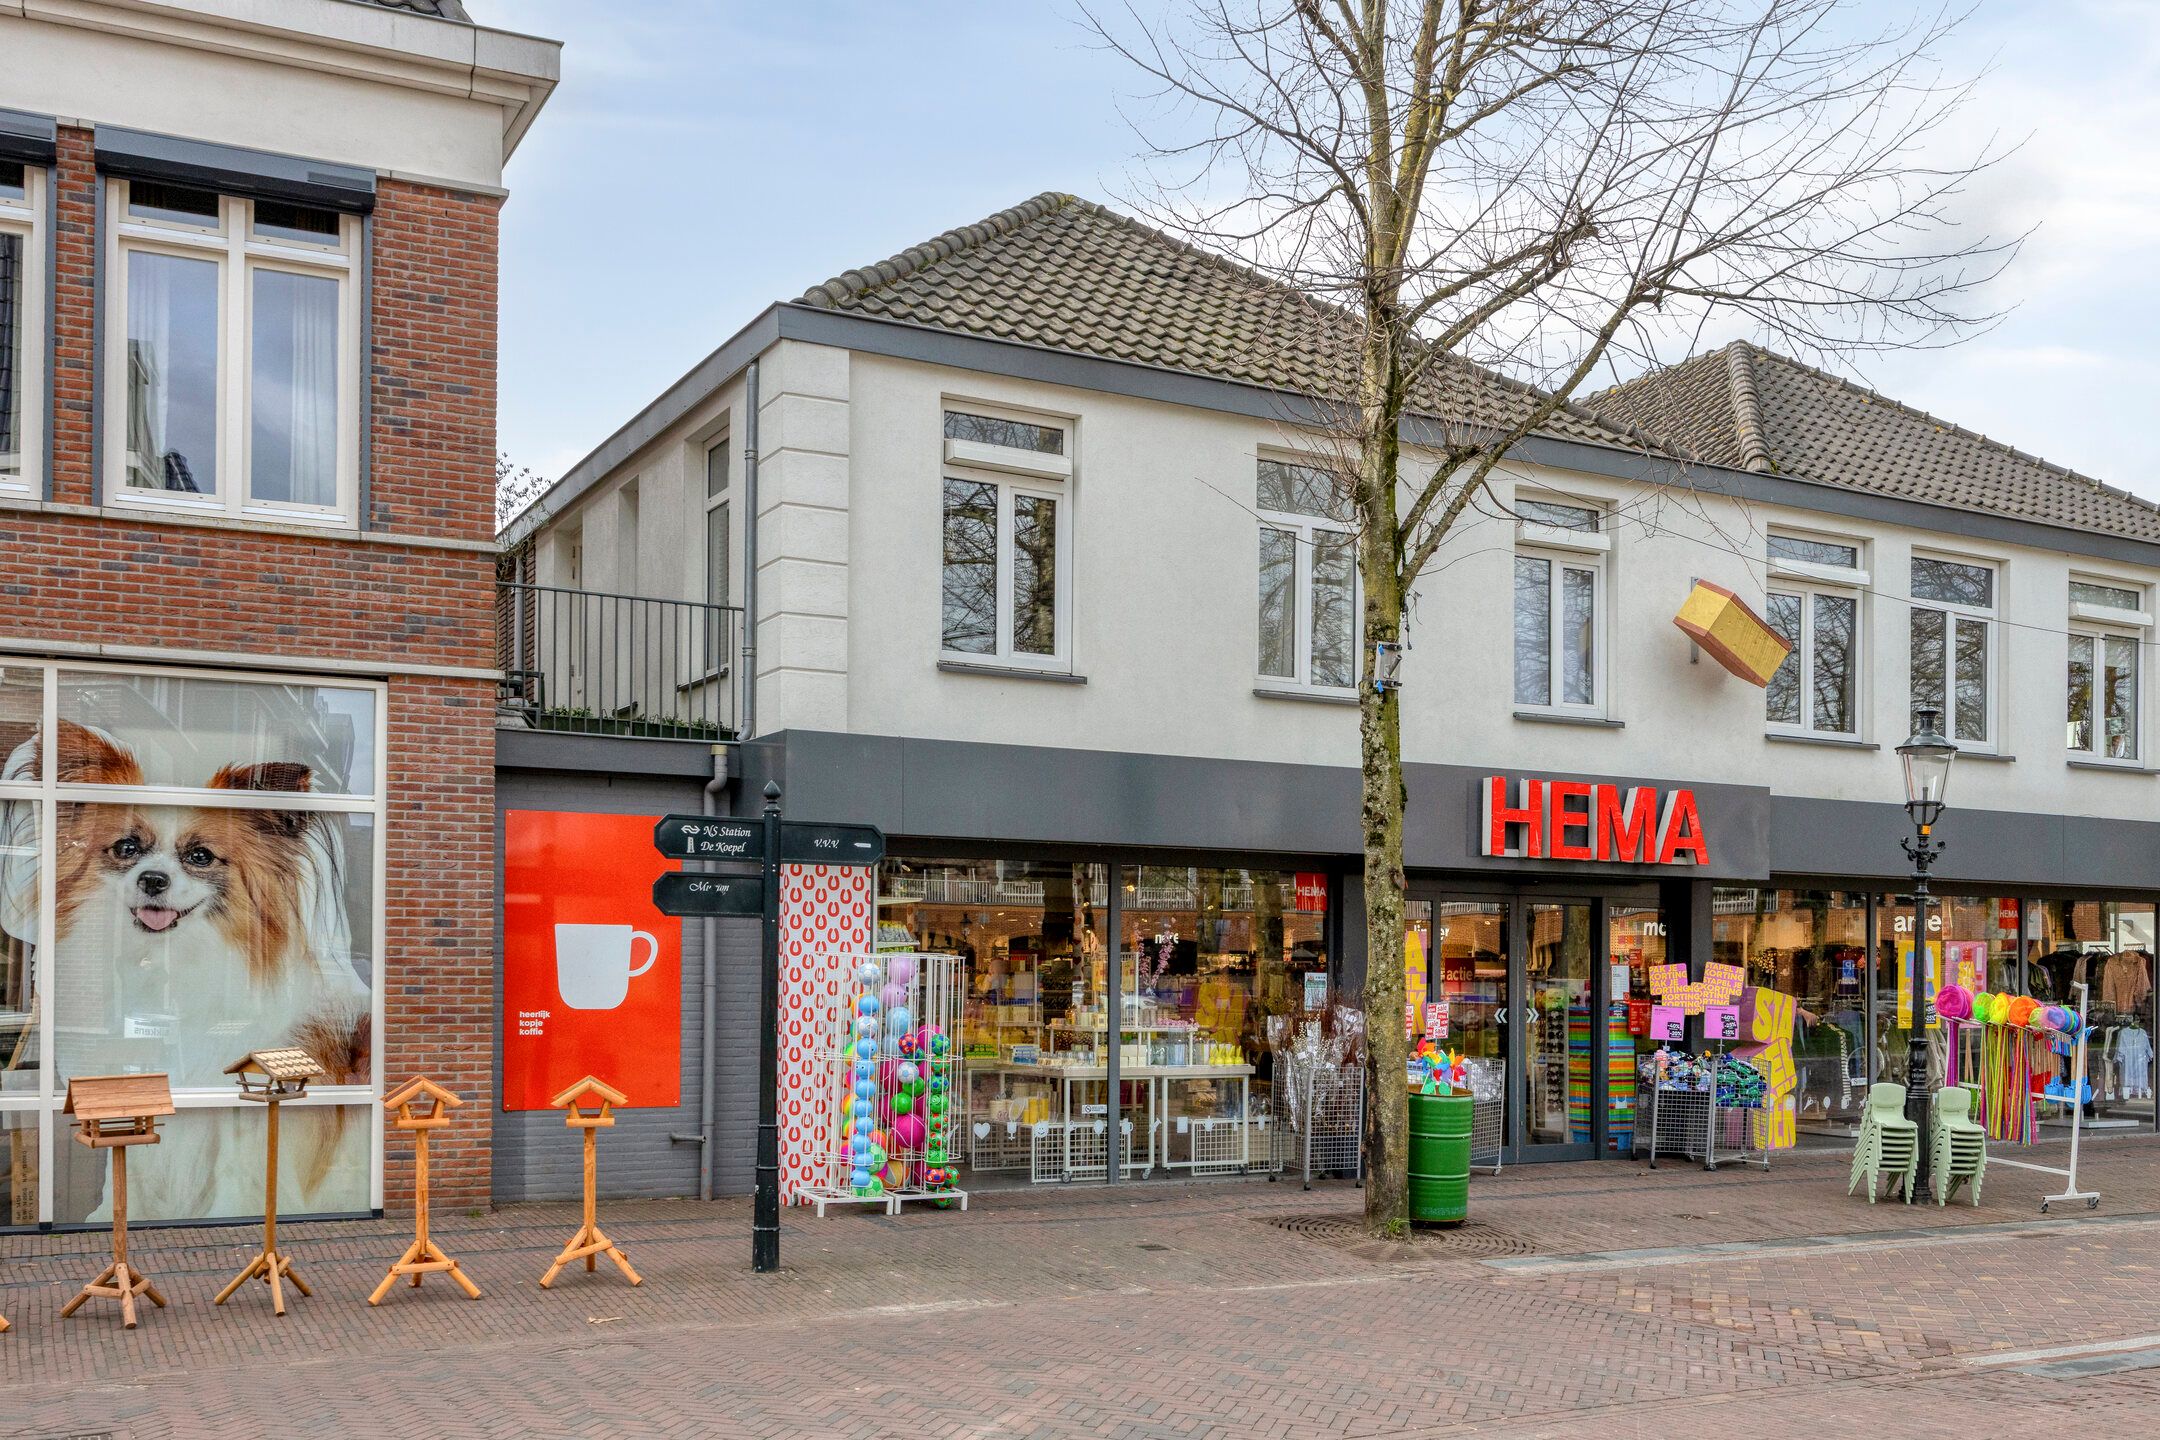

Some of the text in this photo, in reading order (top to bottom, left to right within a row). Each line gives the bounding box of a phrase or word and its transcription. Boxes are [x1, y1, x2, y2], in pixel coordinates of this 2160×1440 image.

[1482, 776, 1710, 865] HEMA
[703, 825, 751, 837] NS Station
[701, 841, 747, 855] De Koepel
[1297, 886, 1326, 897] HEMA
[2000, 910, 2018, 918] HEMA
[1670, 964, 1677, 972] JE
[1706, 962, 1732, 972] STAPEL
[1446, 966, 1473, 981] actie
[1650, 970, 1687, 981] KORTING
[1705, 969, 1744, 980] KORTING
[1671, 979, 1678, 987] JE
[1703, 977, 1732, 987] STAPEL
[1651, 985, 1687, 995] KORTING
[1701, 984, 1742, 996] KORTING
[1662, 993, 1700, 1001] KORTING
[520, 1011, 550, 1019] heerlijk
[1752, 987, 1793, 1046] STA
